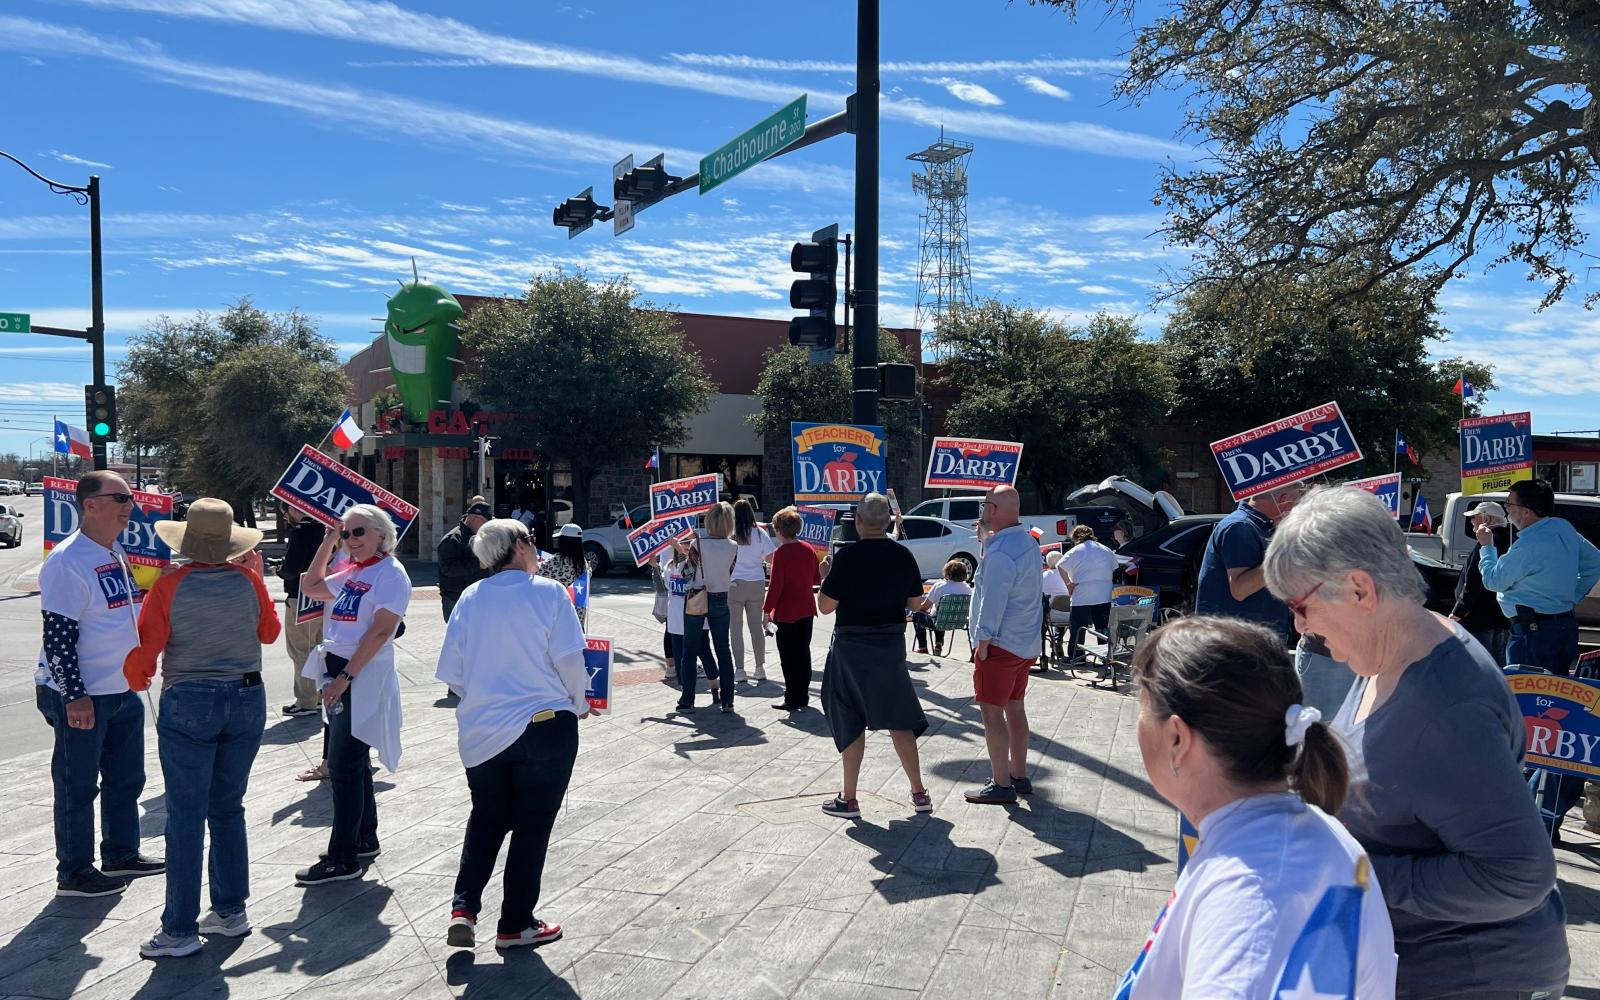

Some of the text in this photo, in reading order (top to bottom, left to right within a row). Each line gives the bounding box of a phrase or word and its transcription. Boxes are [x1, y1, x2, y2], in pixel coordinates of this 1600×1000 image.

[793, 107, 799, 120] St
[713, 119, 787, 180] Chadbourne
[1240, 404, 1335, 443] Re-Elect REPUBLICAN
[1464, 428, 1481, 436] DREW
[806, 427, 871, 445] TEACHERS
[833, 443, 847, 453] for
[977, 443, 1018, 454] REPUBLICAN
[1221, 447, 1242, 459] DREW
[1223, 426, 1344, 486] DARBY
[1465, 435, 1527, 464] DARBY
[303, 457, 322, 471] DREW
[933, 453, 1014, 478] DARBY
[50, 480, 76, 491] RE-EL
[797, 460, 882, 493] DARBY
[1238, 488, 1255, 496] STATE
[1256, 470, 1306, 489] REPRESENTATIVE
[1482, 479, 1512, 490] PFLUGER
[286, 461, 358, 516] DAR
[329, 461, 416, 516] Re-Elect REPUBLICAN
[655, 489, 715, 512] DARBY
[50, 500, 158, 551] DBY
[634, 519, 684, 556] DARBY
[100, 576, 138, 598] DAR
[669, 580, 688, 593] DAR
[1535, 696, 1555, 708] for
[1527, 725, 1600, 763] RBY
